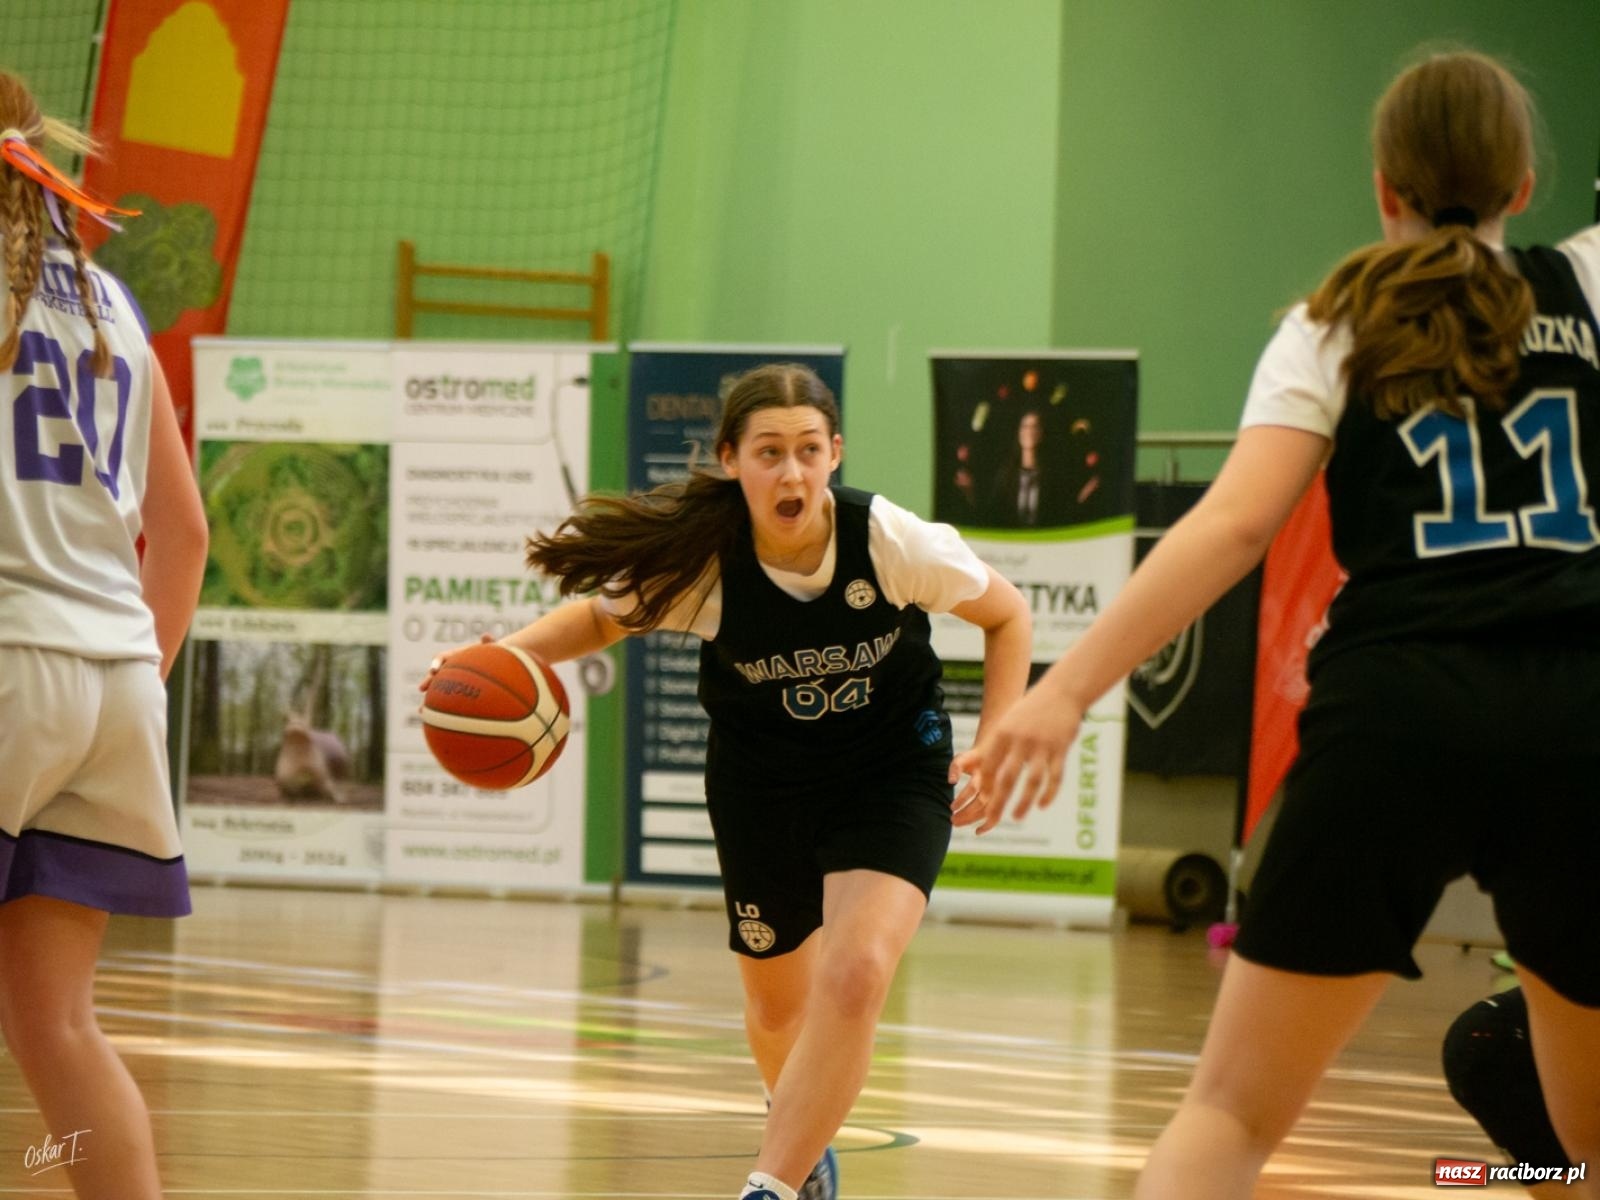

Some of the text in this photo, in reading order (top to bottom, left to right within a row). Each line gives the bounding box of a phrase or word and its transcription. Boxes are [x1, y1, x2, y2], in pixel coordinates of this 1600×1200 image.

[1519, 314, 1600, 370] UZKA
[12, 331, 132, 500] 20
[405, 374, 536, 400] ostromed
[1398, 389, 1600, 558] 11
[1014, 582, 1098, 616] TYKA
[734, 627, 902, 685] WARSAW
[782, 677, 875, 721] 64
[1076, 732, 1099, 849] OFERTA
